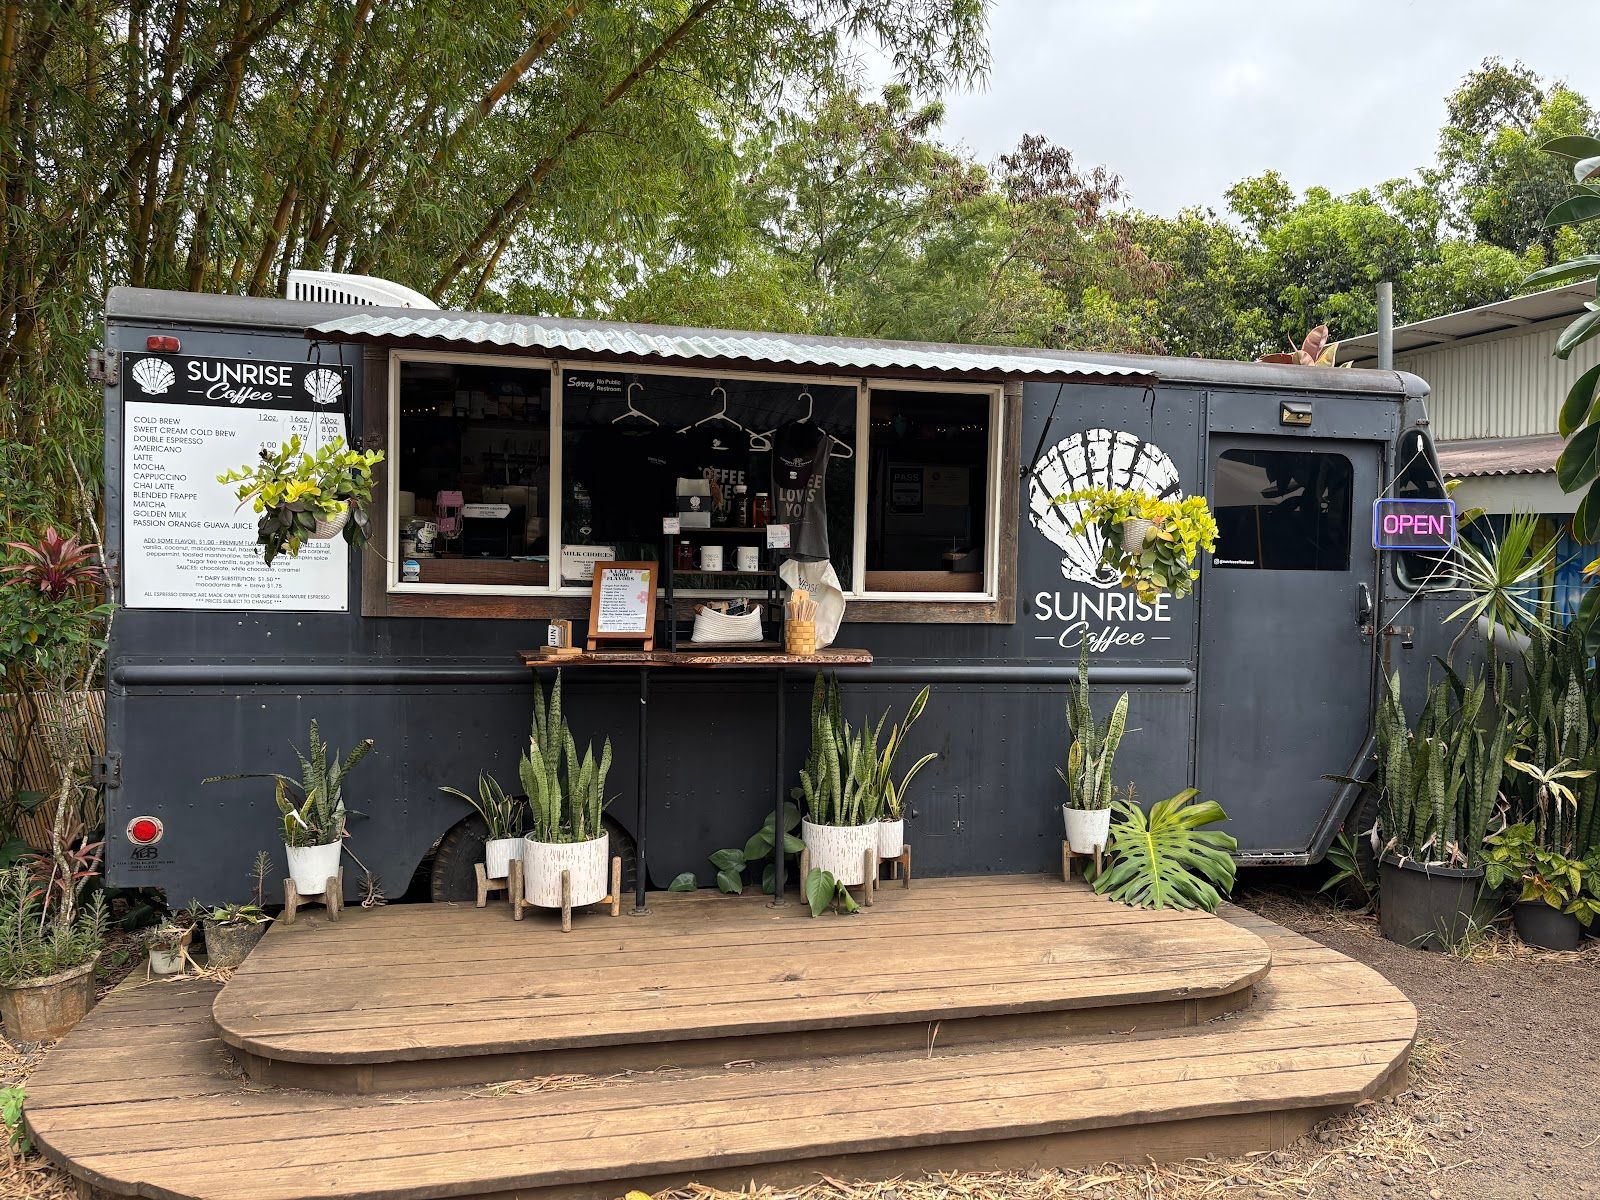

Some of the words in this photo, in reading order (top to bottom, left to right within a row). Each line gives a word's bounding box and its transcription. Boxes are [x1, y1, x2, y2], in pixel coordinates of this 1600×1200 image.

[188, 360, 292, 386] SUNRISE
[567, 376, 594, 390] Sorry
[206, 382, 273, 404] Coffee
[134, 416, 157, 424] COLD
[258, 414, 278, 422] 12oz.
[290, 416, 310, 424] 16oz.
[320, 417, 340, 425] 20oz.
[166, 437, 203, 445] ESPRESSO
[134, 445, 182, 453] AMERICANO
[133, 472, 187, 481] CAPPUCCINO
[894, 473, 920, 482] PASS
[780, 488, 816, 502] LOVS
[133, 510, 167, 518] GOLDEN
[1384, 514, 1444, 534] OPEN
[1034, 591, 1172, 621] SUNRISE
[1059, 621, 1146, 652] Coffee
